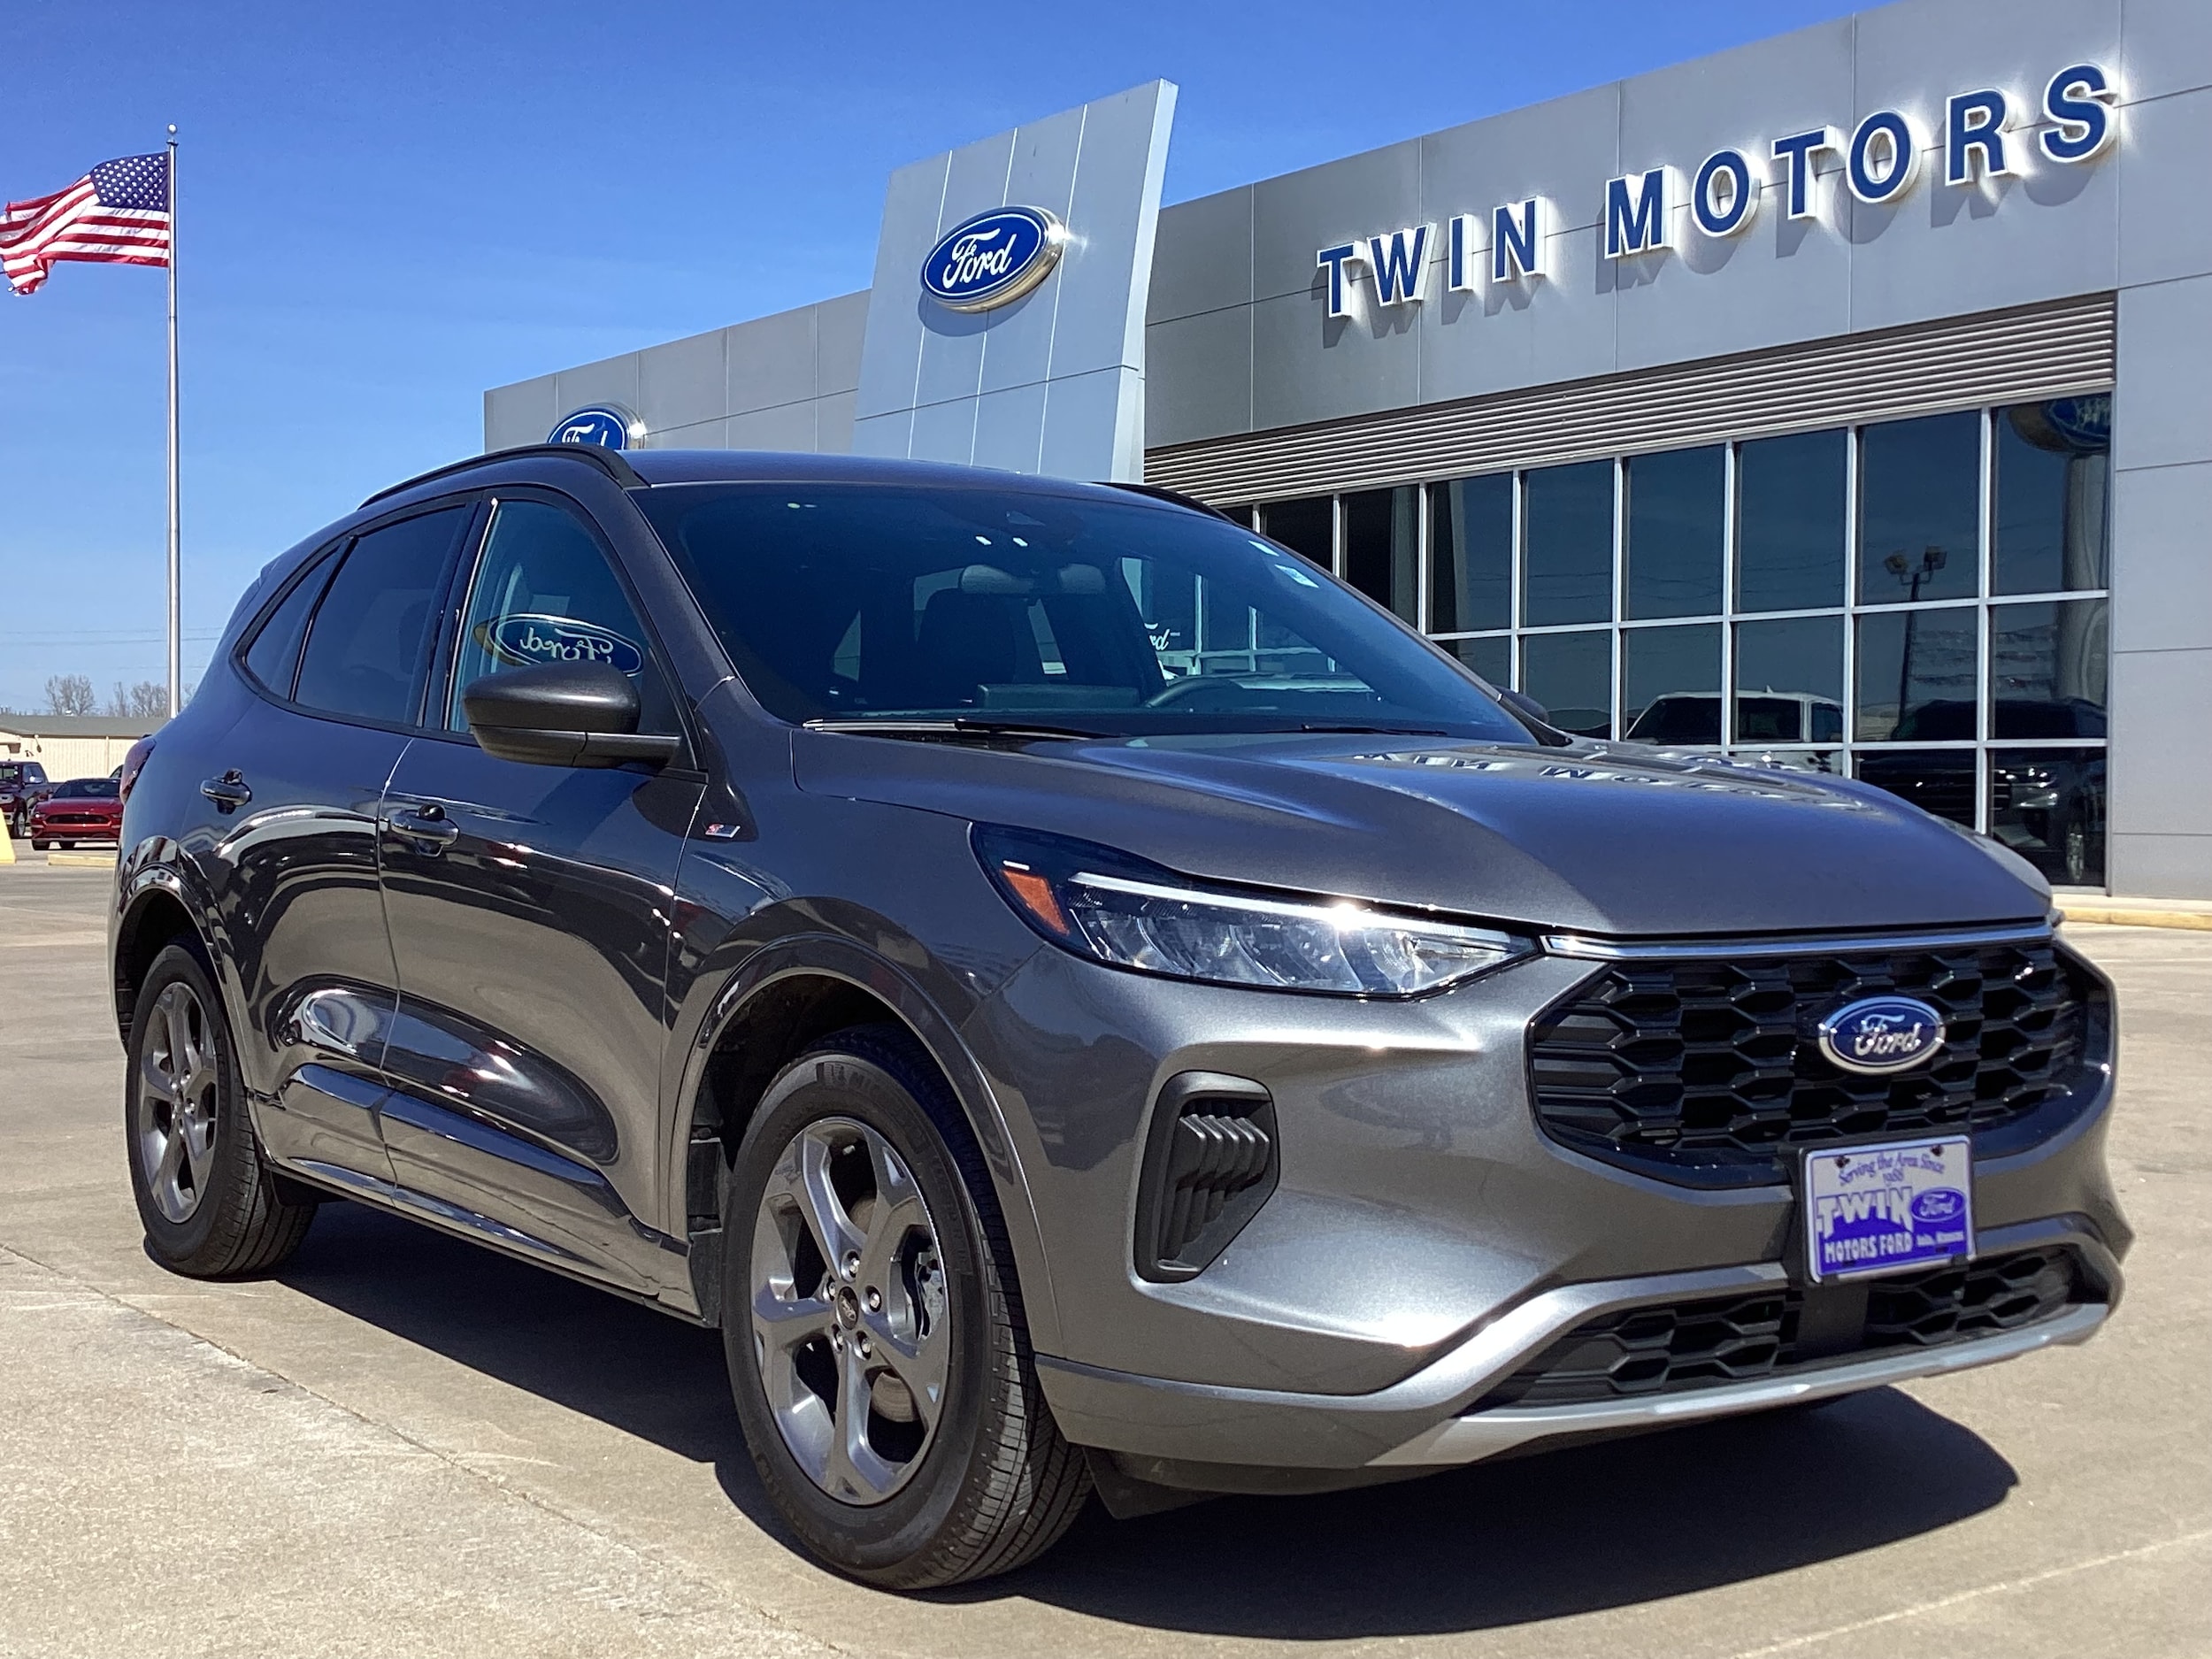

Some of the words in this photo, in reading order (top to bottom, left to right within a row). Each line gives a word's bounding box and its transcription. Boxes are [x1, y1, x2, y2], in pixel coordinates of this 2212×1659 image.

[1317, 196, 1546, 318] TWIN
[1604, 62, 2118, 259] MOTORS
[942, 227, 1017, 289] Ford
[1853, 1013, 1922, 1056] Ford
[1816, 1187, 1914, 1240] TWIN
[1920, 1194, 1955, 1217] Ford
[1824, 1235, 1878, 1264] MOTORS
[1879, 1231, 1914, 1256] FORD
